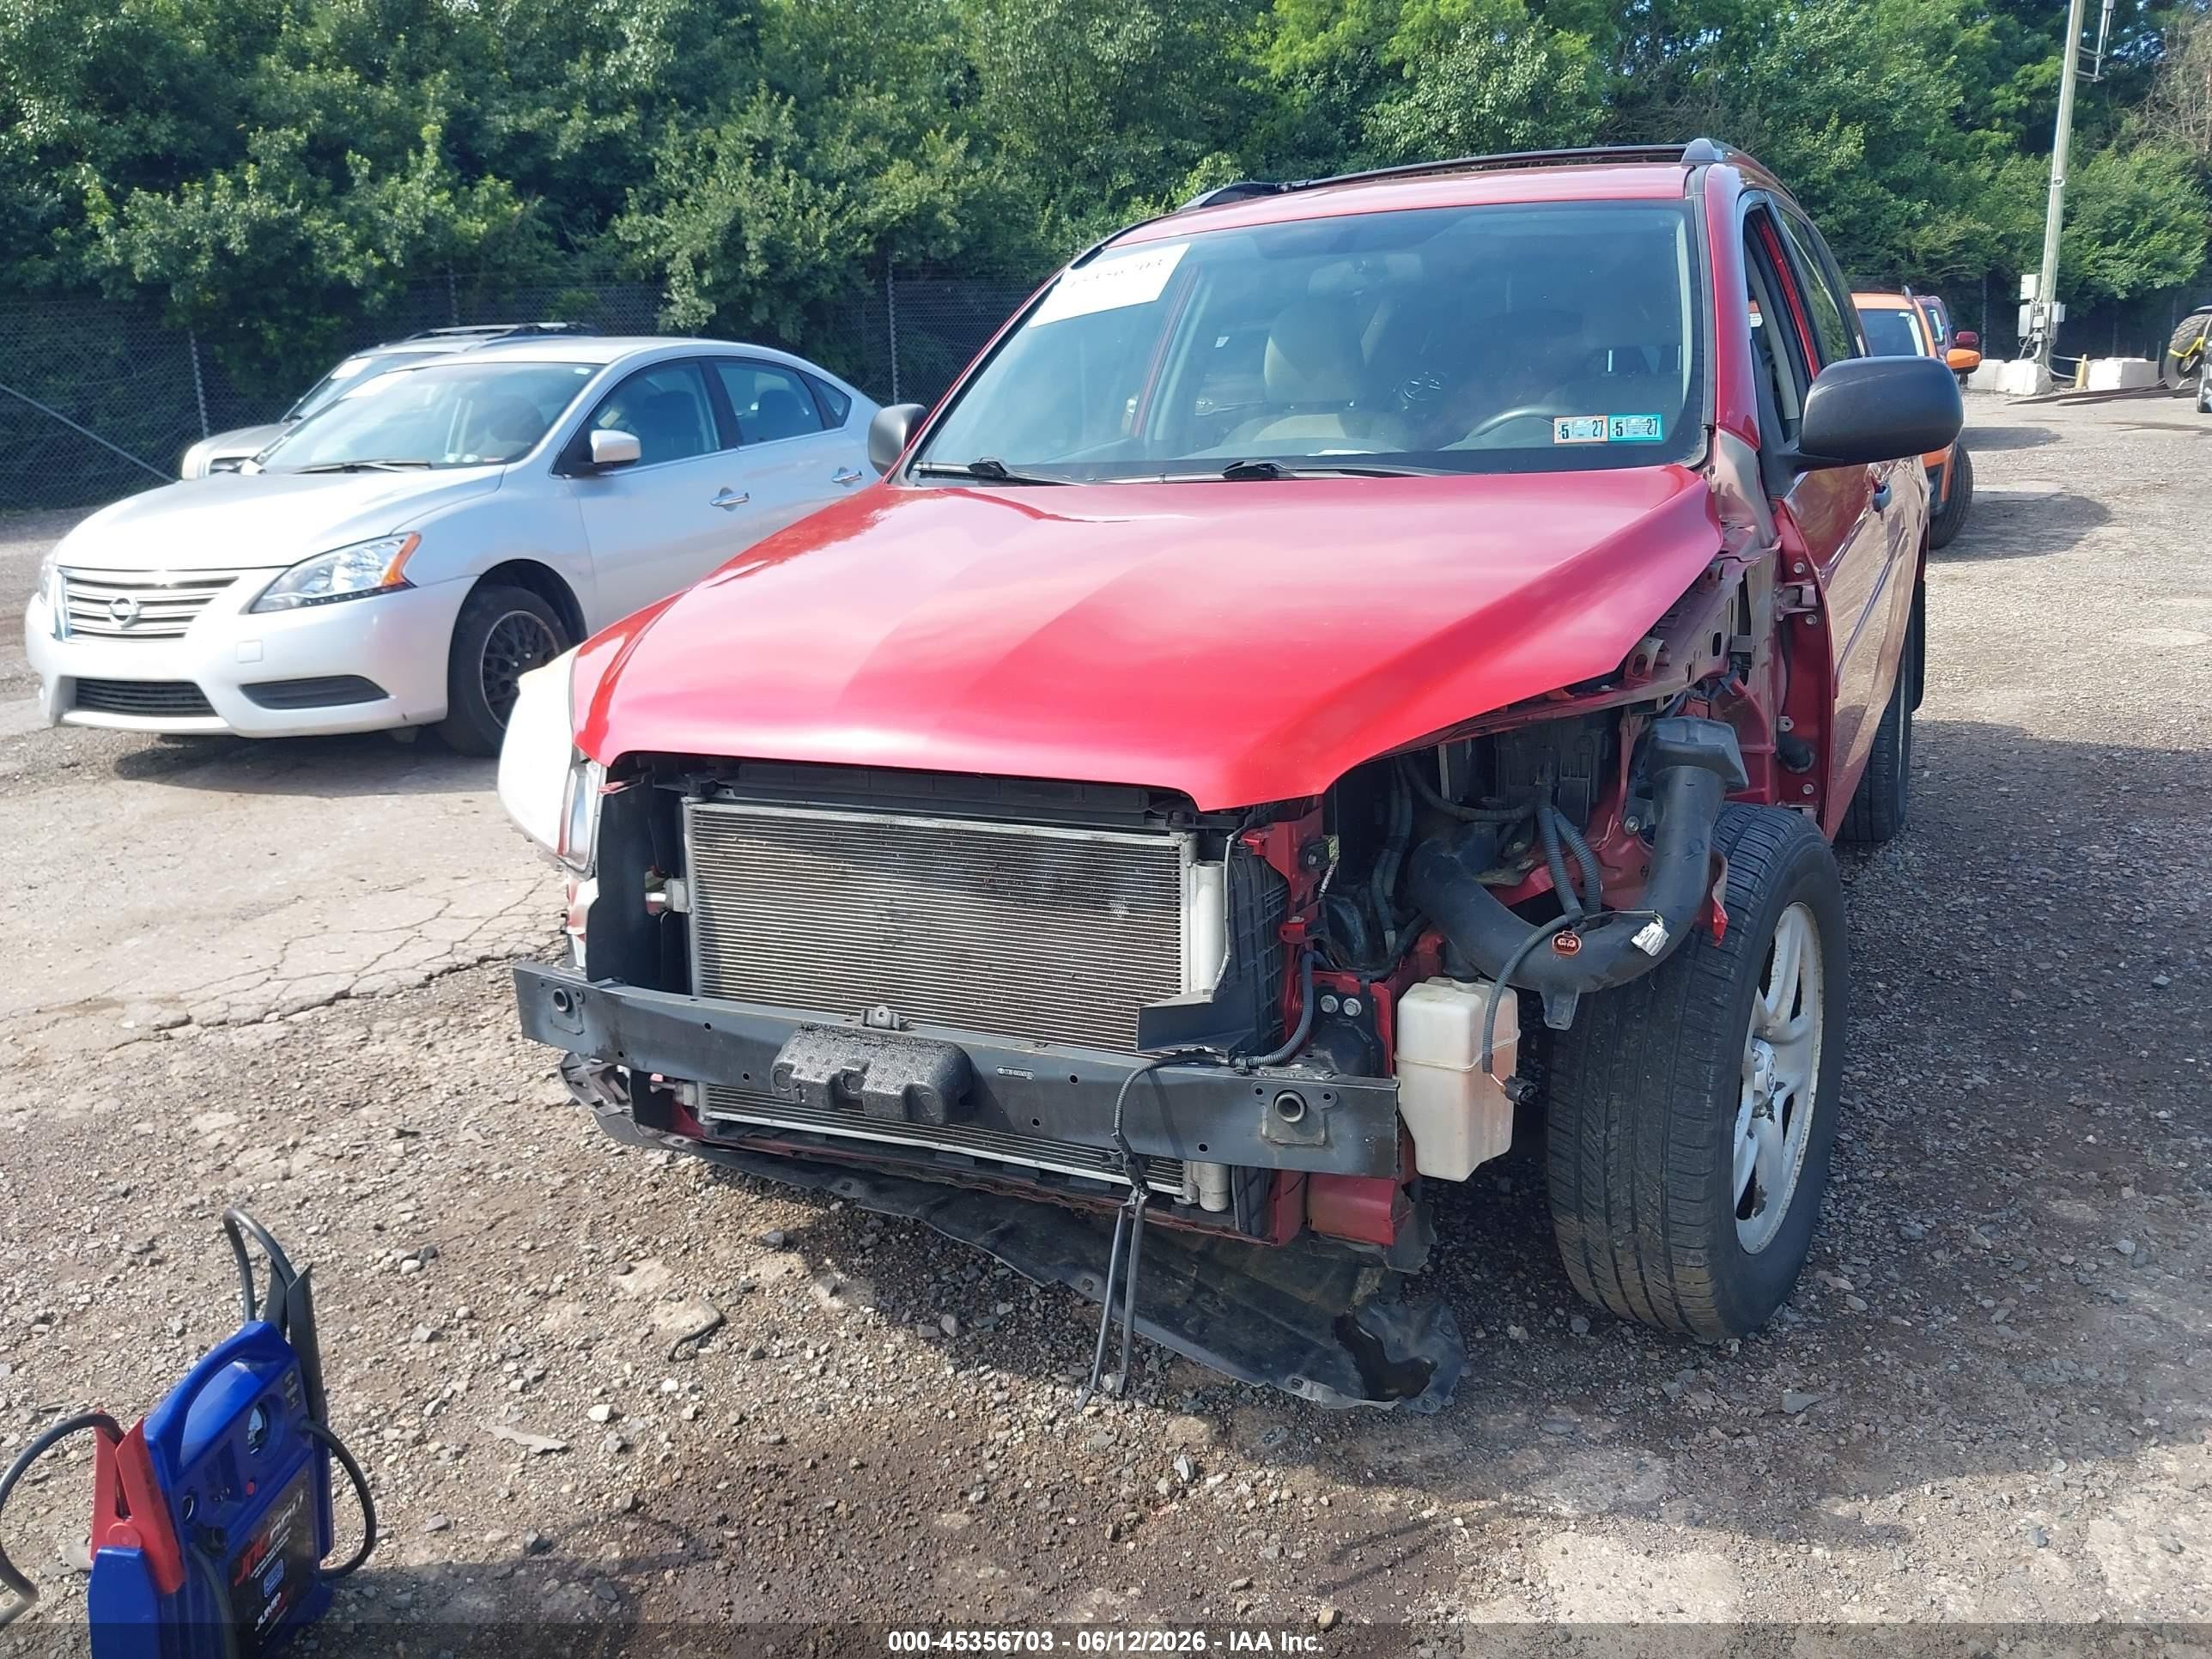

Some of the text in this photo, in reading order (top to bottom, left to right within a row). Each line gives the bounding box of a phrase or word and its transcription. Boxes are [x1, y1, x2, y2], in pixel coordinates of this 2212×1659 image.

[1561, 424, 1570, 440] 5
[1592, 419, 1604, 439] 27
[1615, 422, 1623, 437] 5
[1646, 418, 1658, 436] 27
